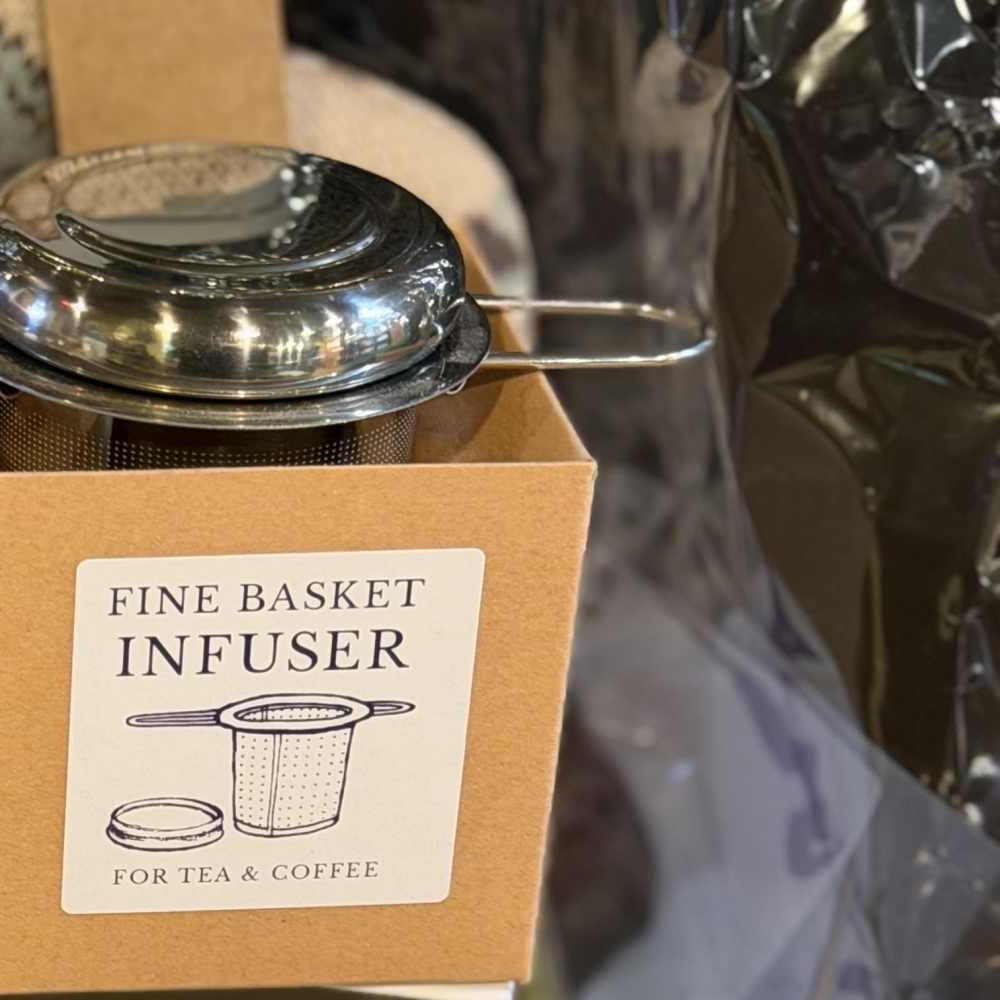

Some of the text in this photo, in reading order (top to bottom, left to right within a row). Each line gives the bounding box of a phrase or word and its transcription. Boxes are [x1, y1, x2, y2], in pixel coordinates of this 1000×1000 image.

[107, 578, 426, 616] FINE BASKET
[115, 628, 410, 678] INFUSER
[112, 860, 380, 886] FOR TEA & COFFEE
